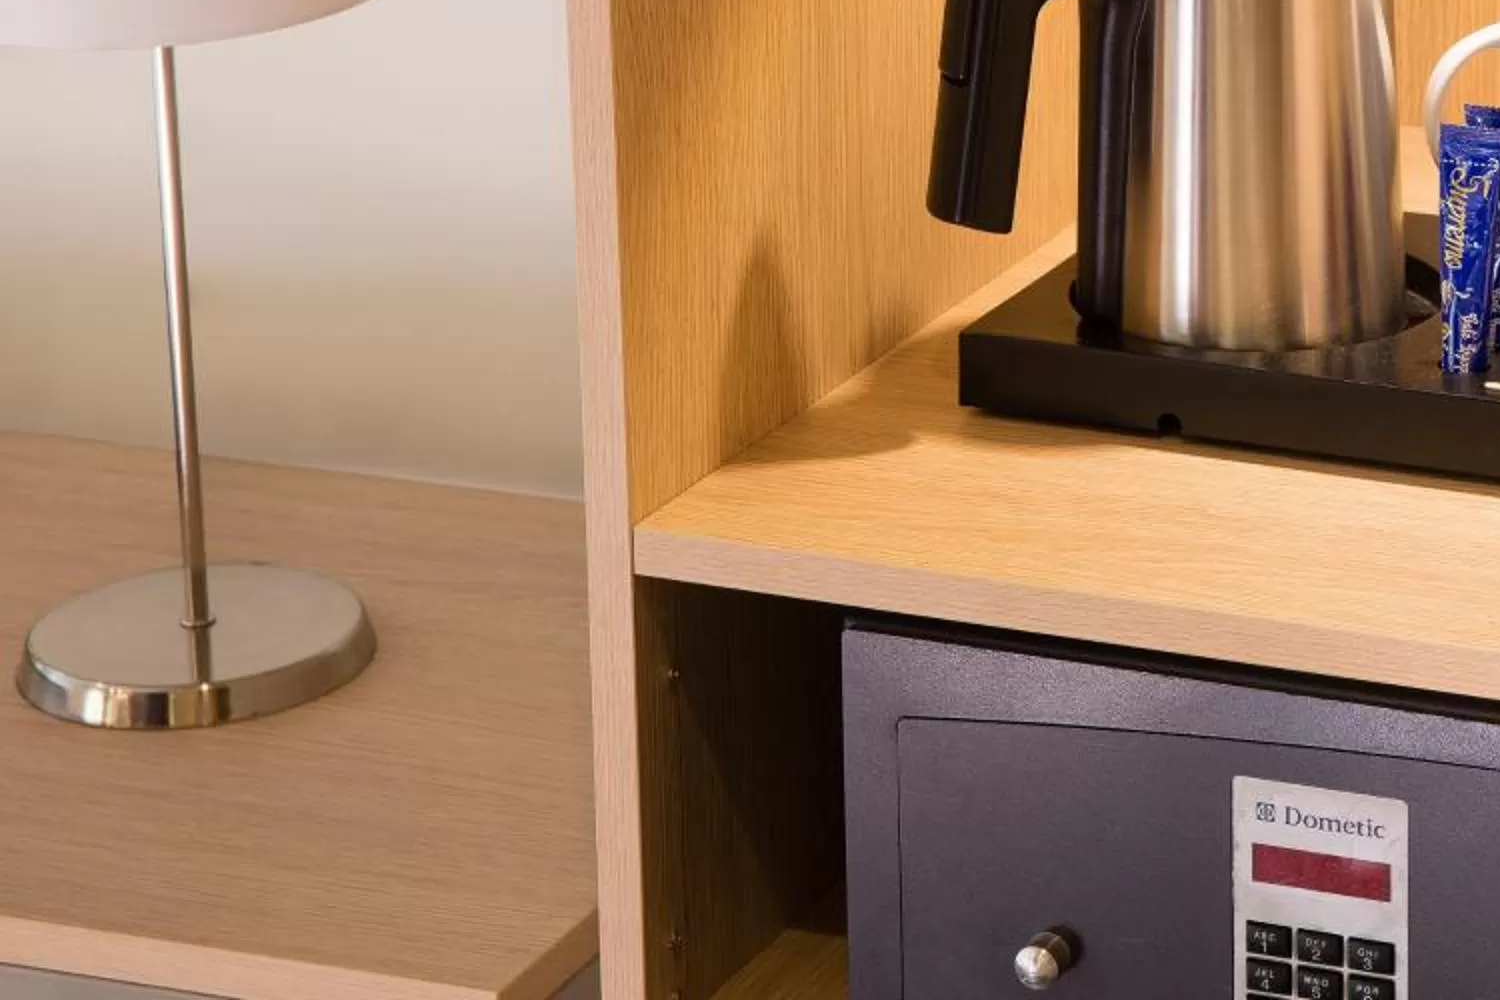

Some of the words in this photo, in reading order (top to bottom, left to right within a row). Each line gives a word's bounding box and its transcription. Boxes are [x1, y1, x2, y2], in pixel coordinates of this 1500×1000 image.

[1443, 166, 1493, 269] Supremo
[1284, 804, 1387, 839] Dometic
[1311, 949, 1322, 961] 2
[1363, 958, 1373, 971] 3
[1260, 978, 1269, 990] 4
